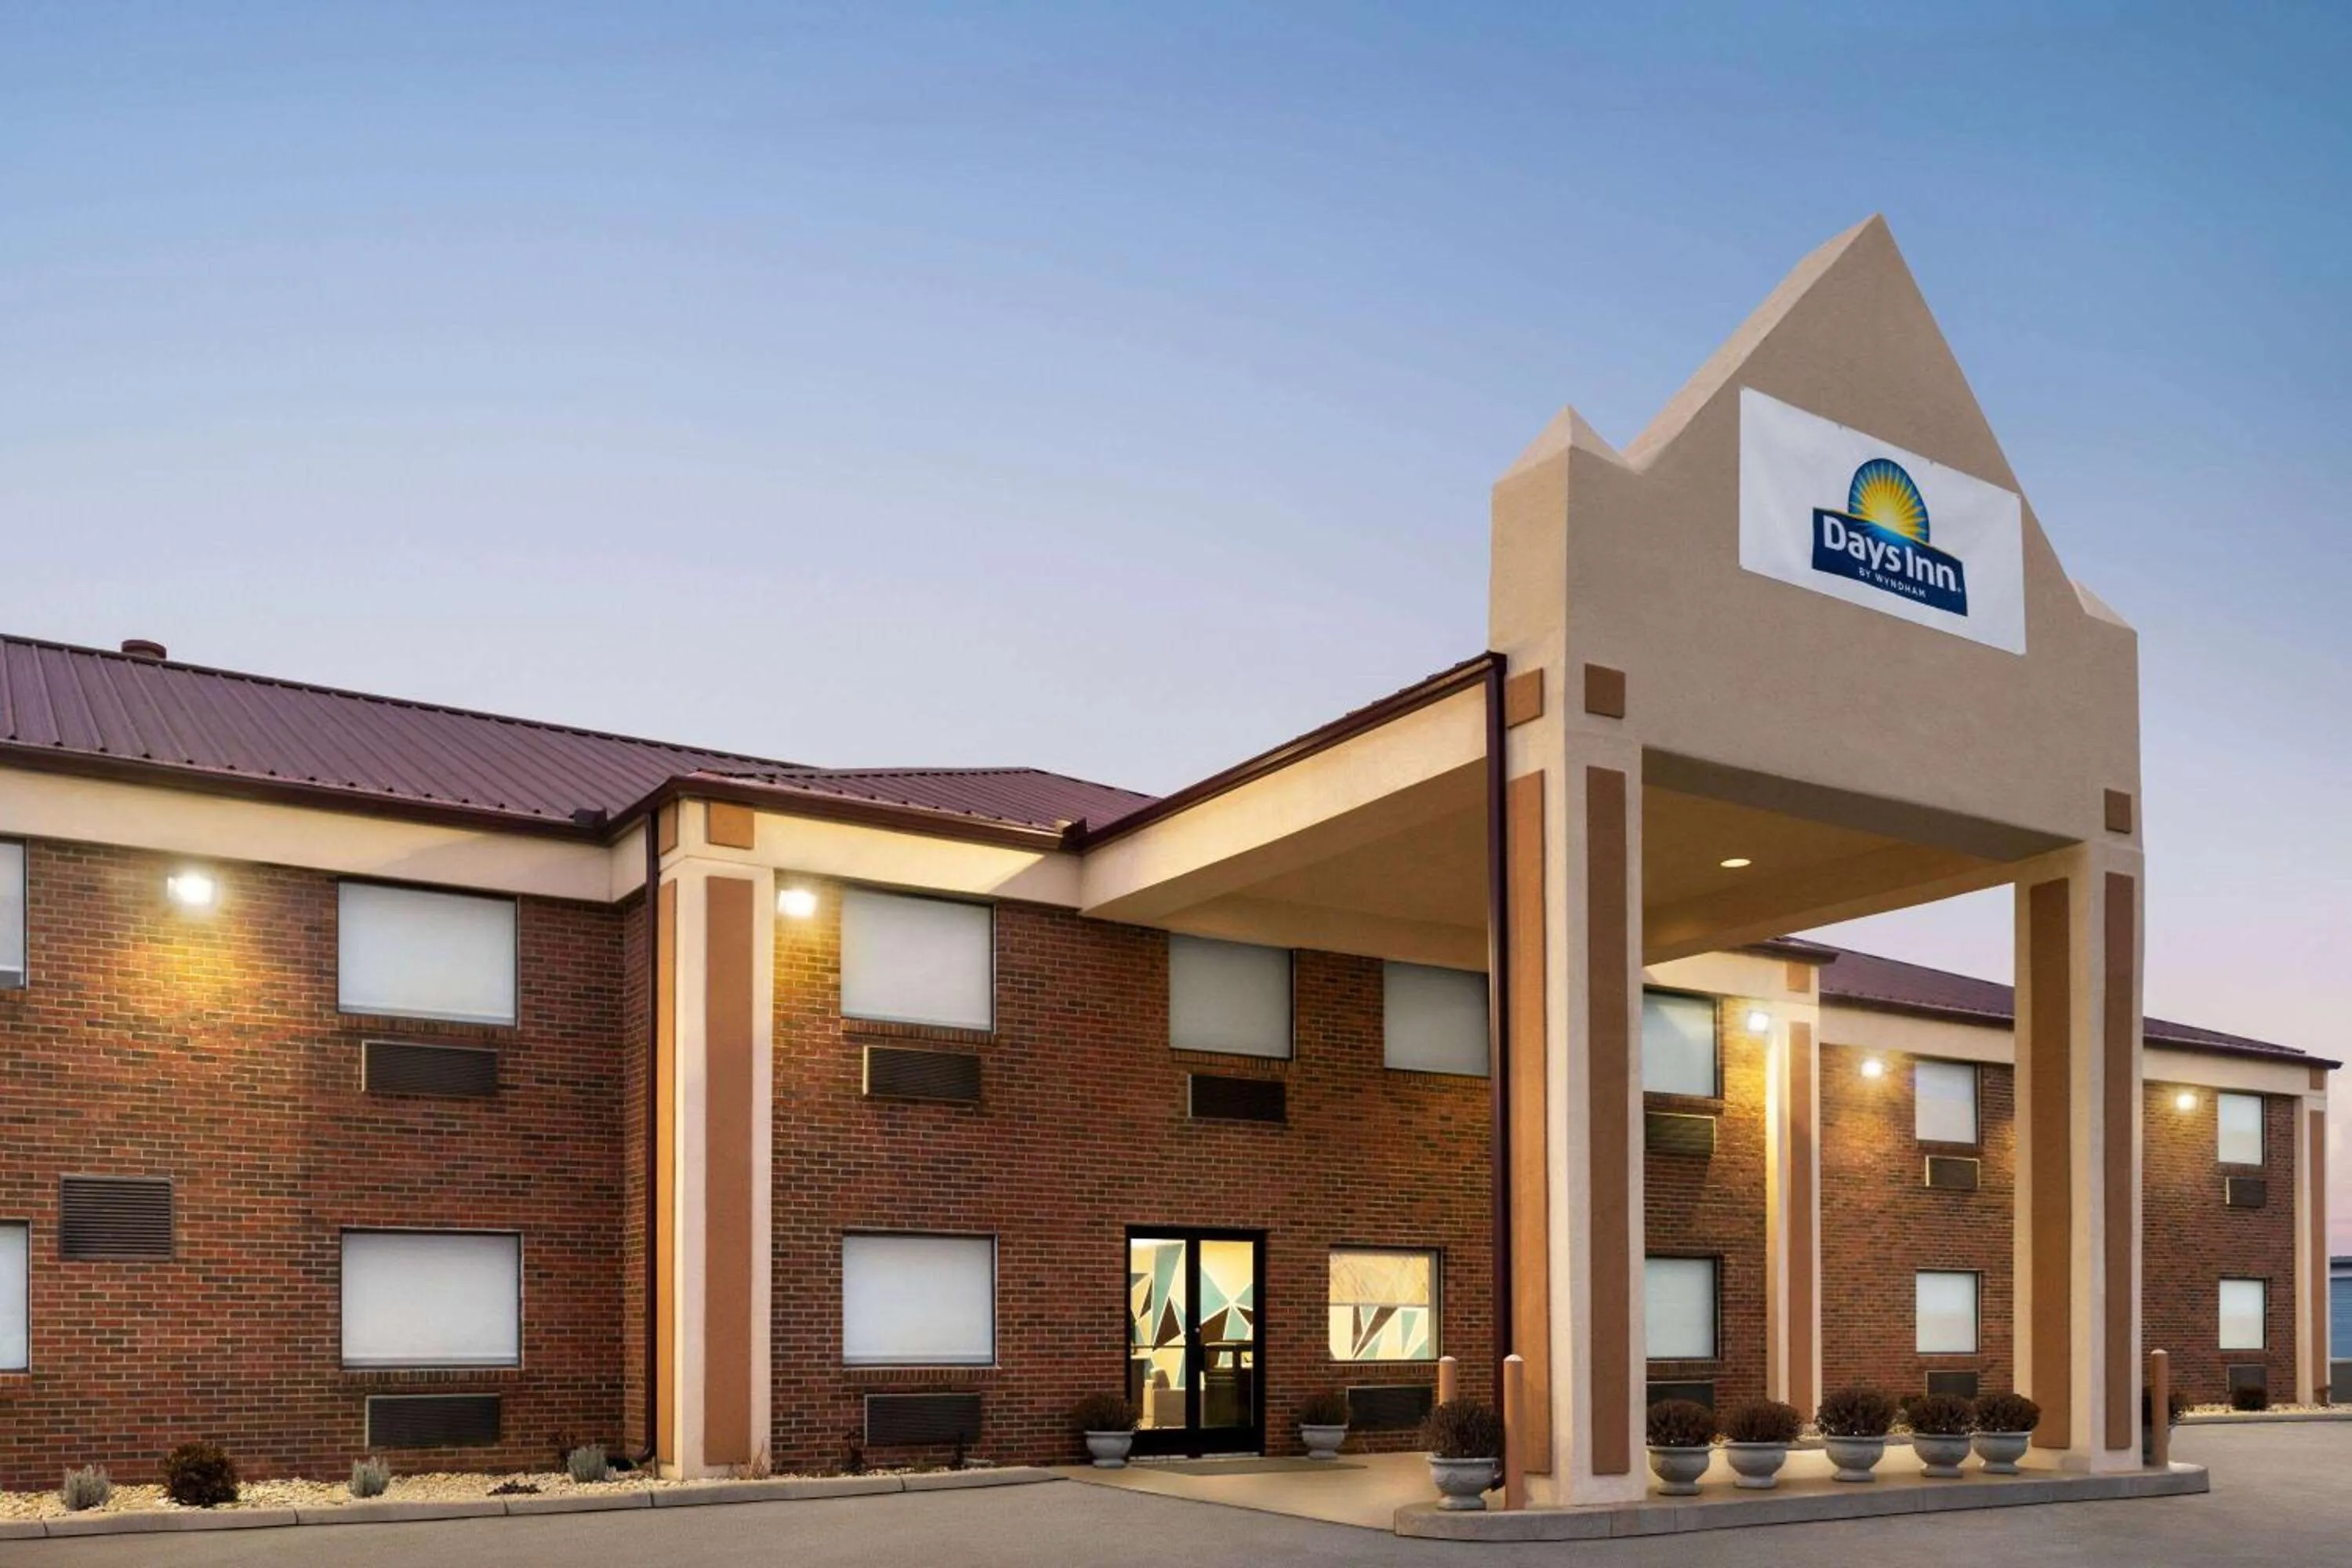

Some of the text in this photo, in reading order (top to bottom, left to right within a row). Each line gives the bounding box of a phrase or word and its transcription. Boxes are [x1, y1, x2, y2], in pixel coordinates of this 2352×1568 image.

[1823, 514, 1957, 593] Days Inn
[1858, 566, 1926, 598] BY WYNDHAM
